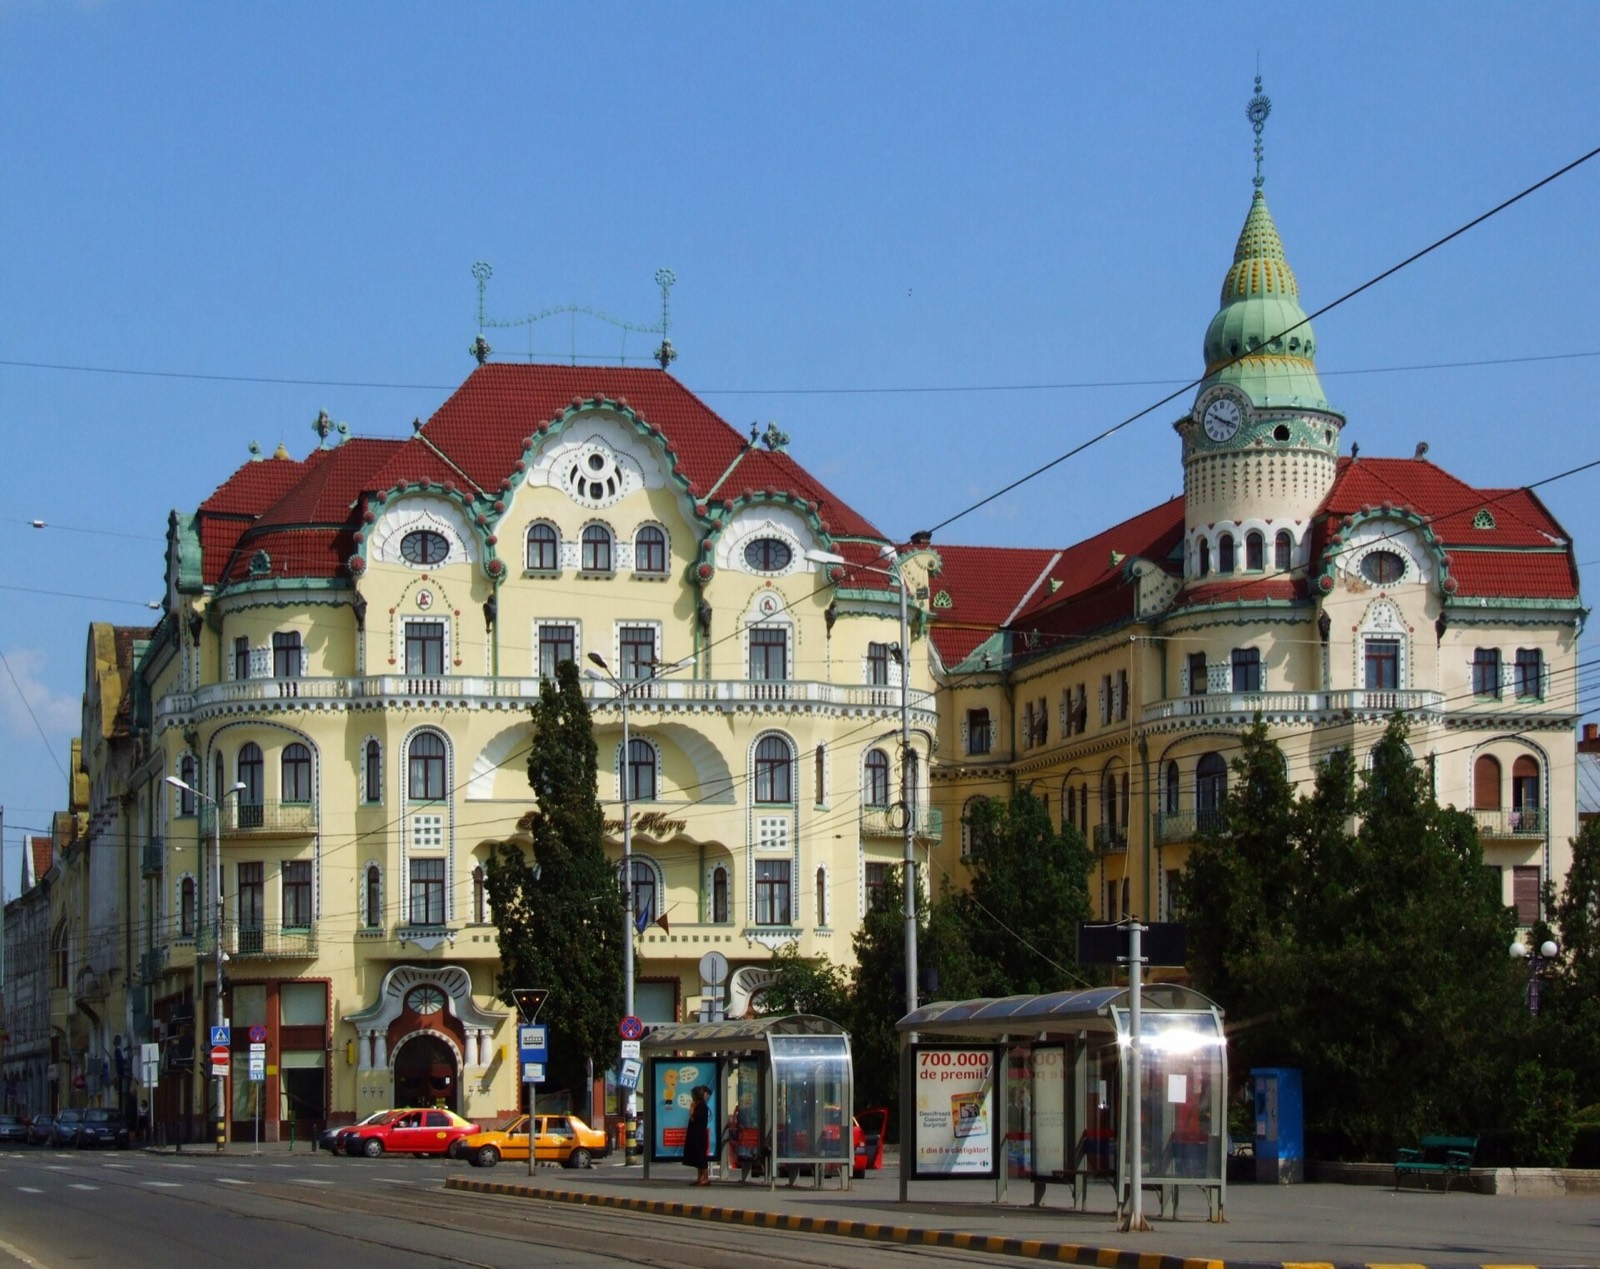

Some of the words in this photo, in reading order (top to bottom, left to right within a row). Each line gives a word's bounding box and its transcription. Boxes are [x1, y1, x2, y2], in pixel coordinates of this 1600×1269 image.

[920, 1052, 989, 1066] 700.000
[920, 1069, 937, 1080] de
[941, 1067, 988, 1082] premii!
[620, 1077, 637, 1089] TAXI
[926, 1146, 938, 1154] din
